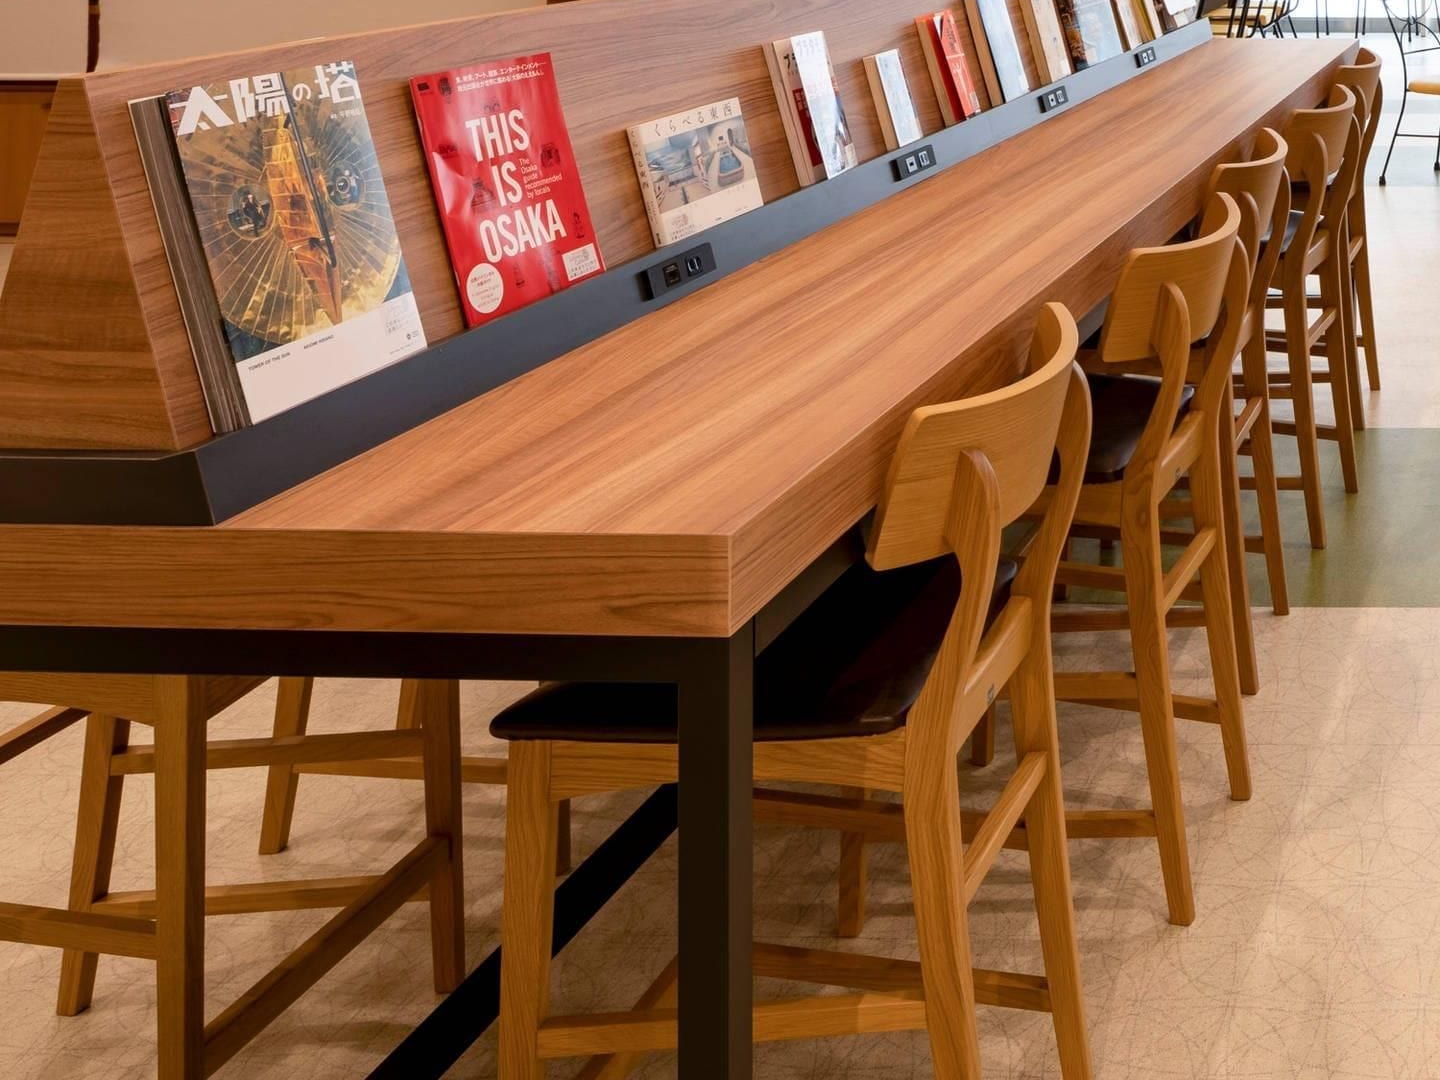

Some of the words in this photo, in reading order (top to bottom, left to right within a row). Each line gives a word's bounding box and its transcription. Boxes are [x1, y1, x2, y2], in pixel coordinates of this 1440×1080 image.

[169, 60, 361, 136] 太陽の塔
[465, 109, 530, 162] THIS
[491, 161, 523, 207] IS
[518, 157, 530, 166] The
[520, 164, 538, 175] Osaka
[525, 172, 563, 190] recommended
[479, 198, 568, 263] OSAKA
